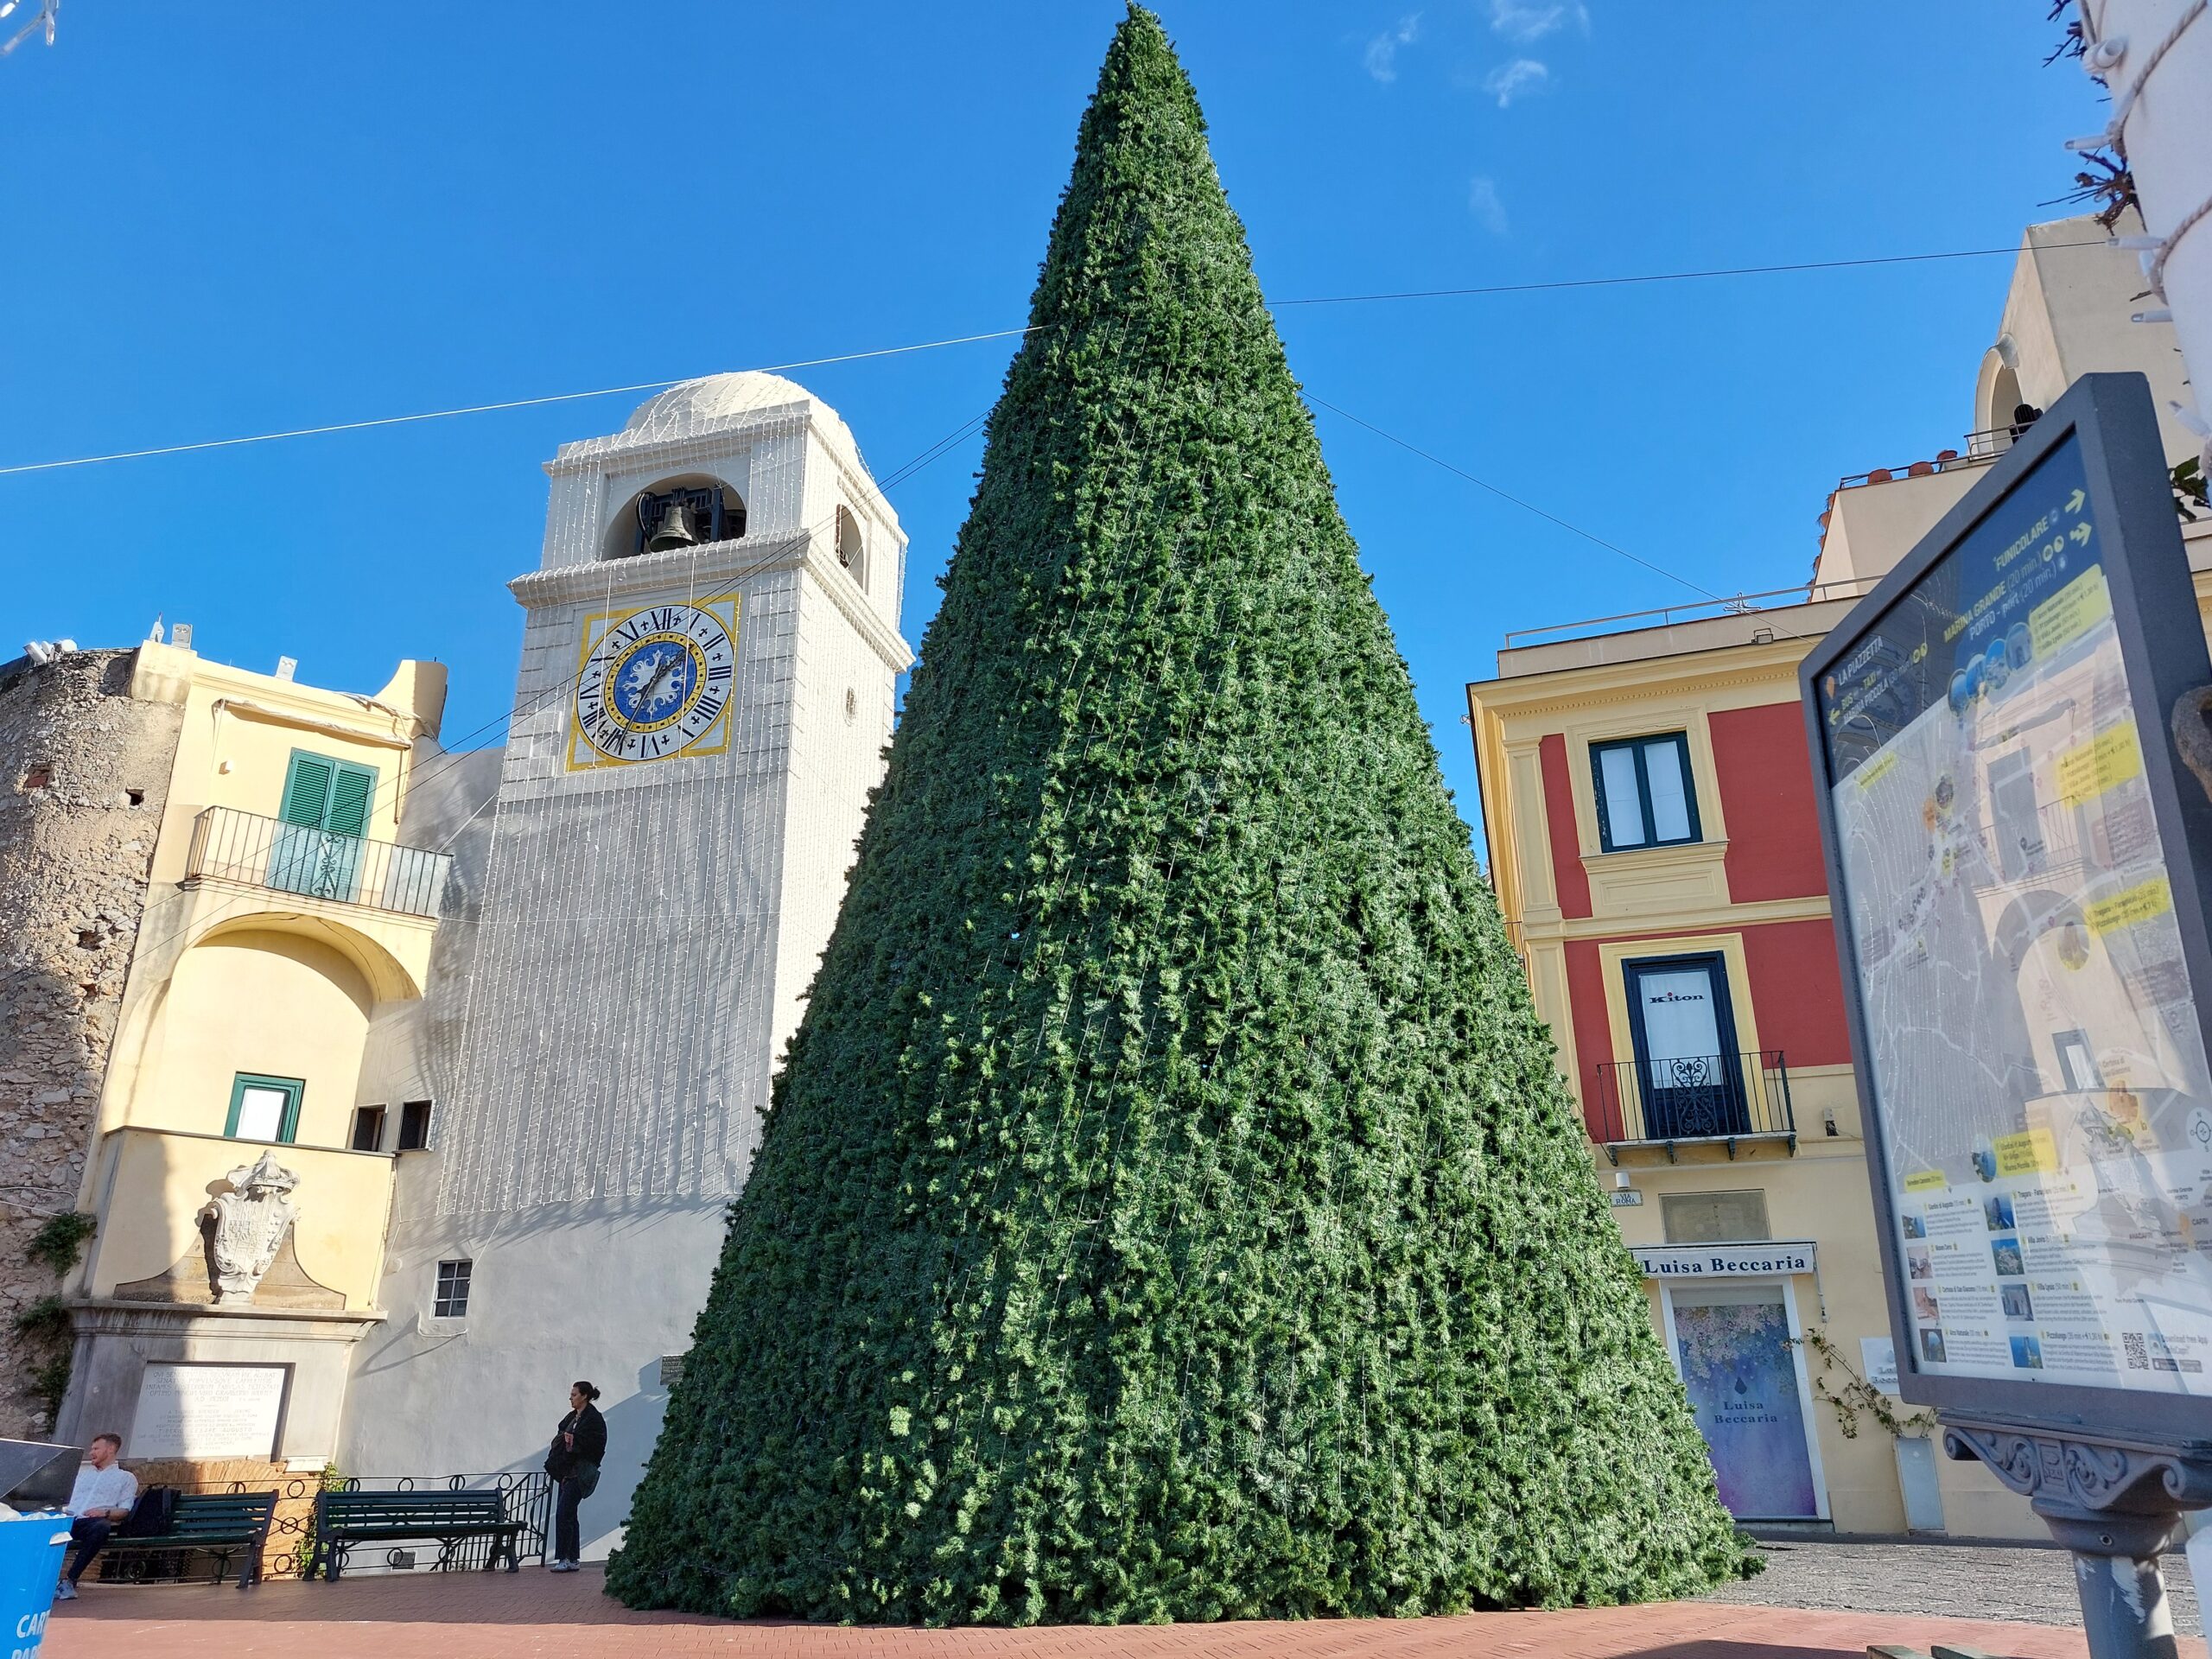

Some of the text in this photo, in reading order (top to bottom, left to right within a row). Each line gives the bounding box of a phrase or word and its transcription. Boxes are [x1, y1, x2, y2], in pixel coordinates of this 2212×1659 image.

[1996, 516, 2050, 572] FUNICOLARE
[1944, 611, 1974, 643] MARINA
[1974, 581, 2006, 617] GRANDE
[1969, 610, 1996, 641] PORTO
[1838, 635, 1884, 686] LA PIAZZETTA
[1649, 992, 1704, 1004] Kiton
[1643, 1255, 1806, 1274] Luisa Beccaria
[1724, 1400, 1764, 1411] Luisa
[1713, 1413, 1777, 1425] Beccaria
